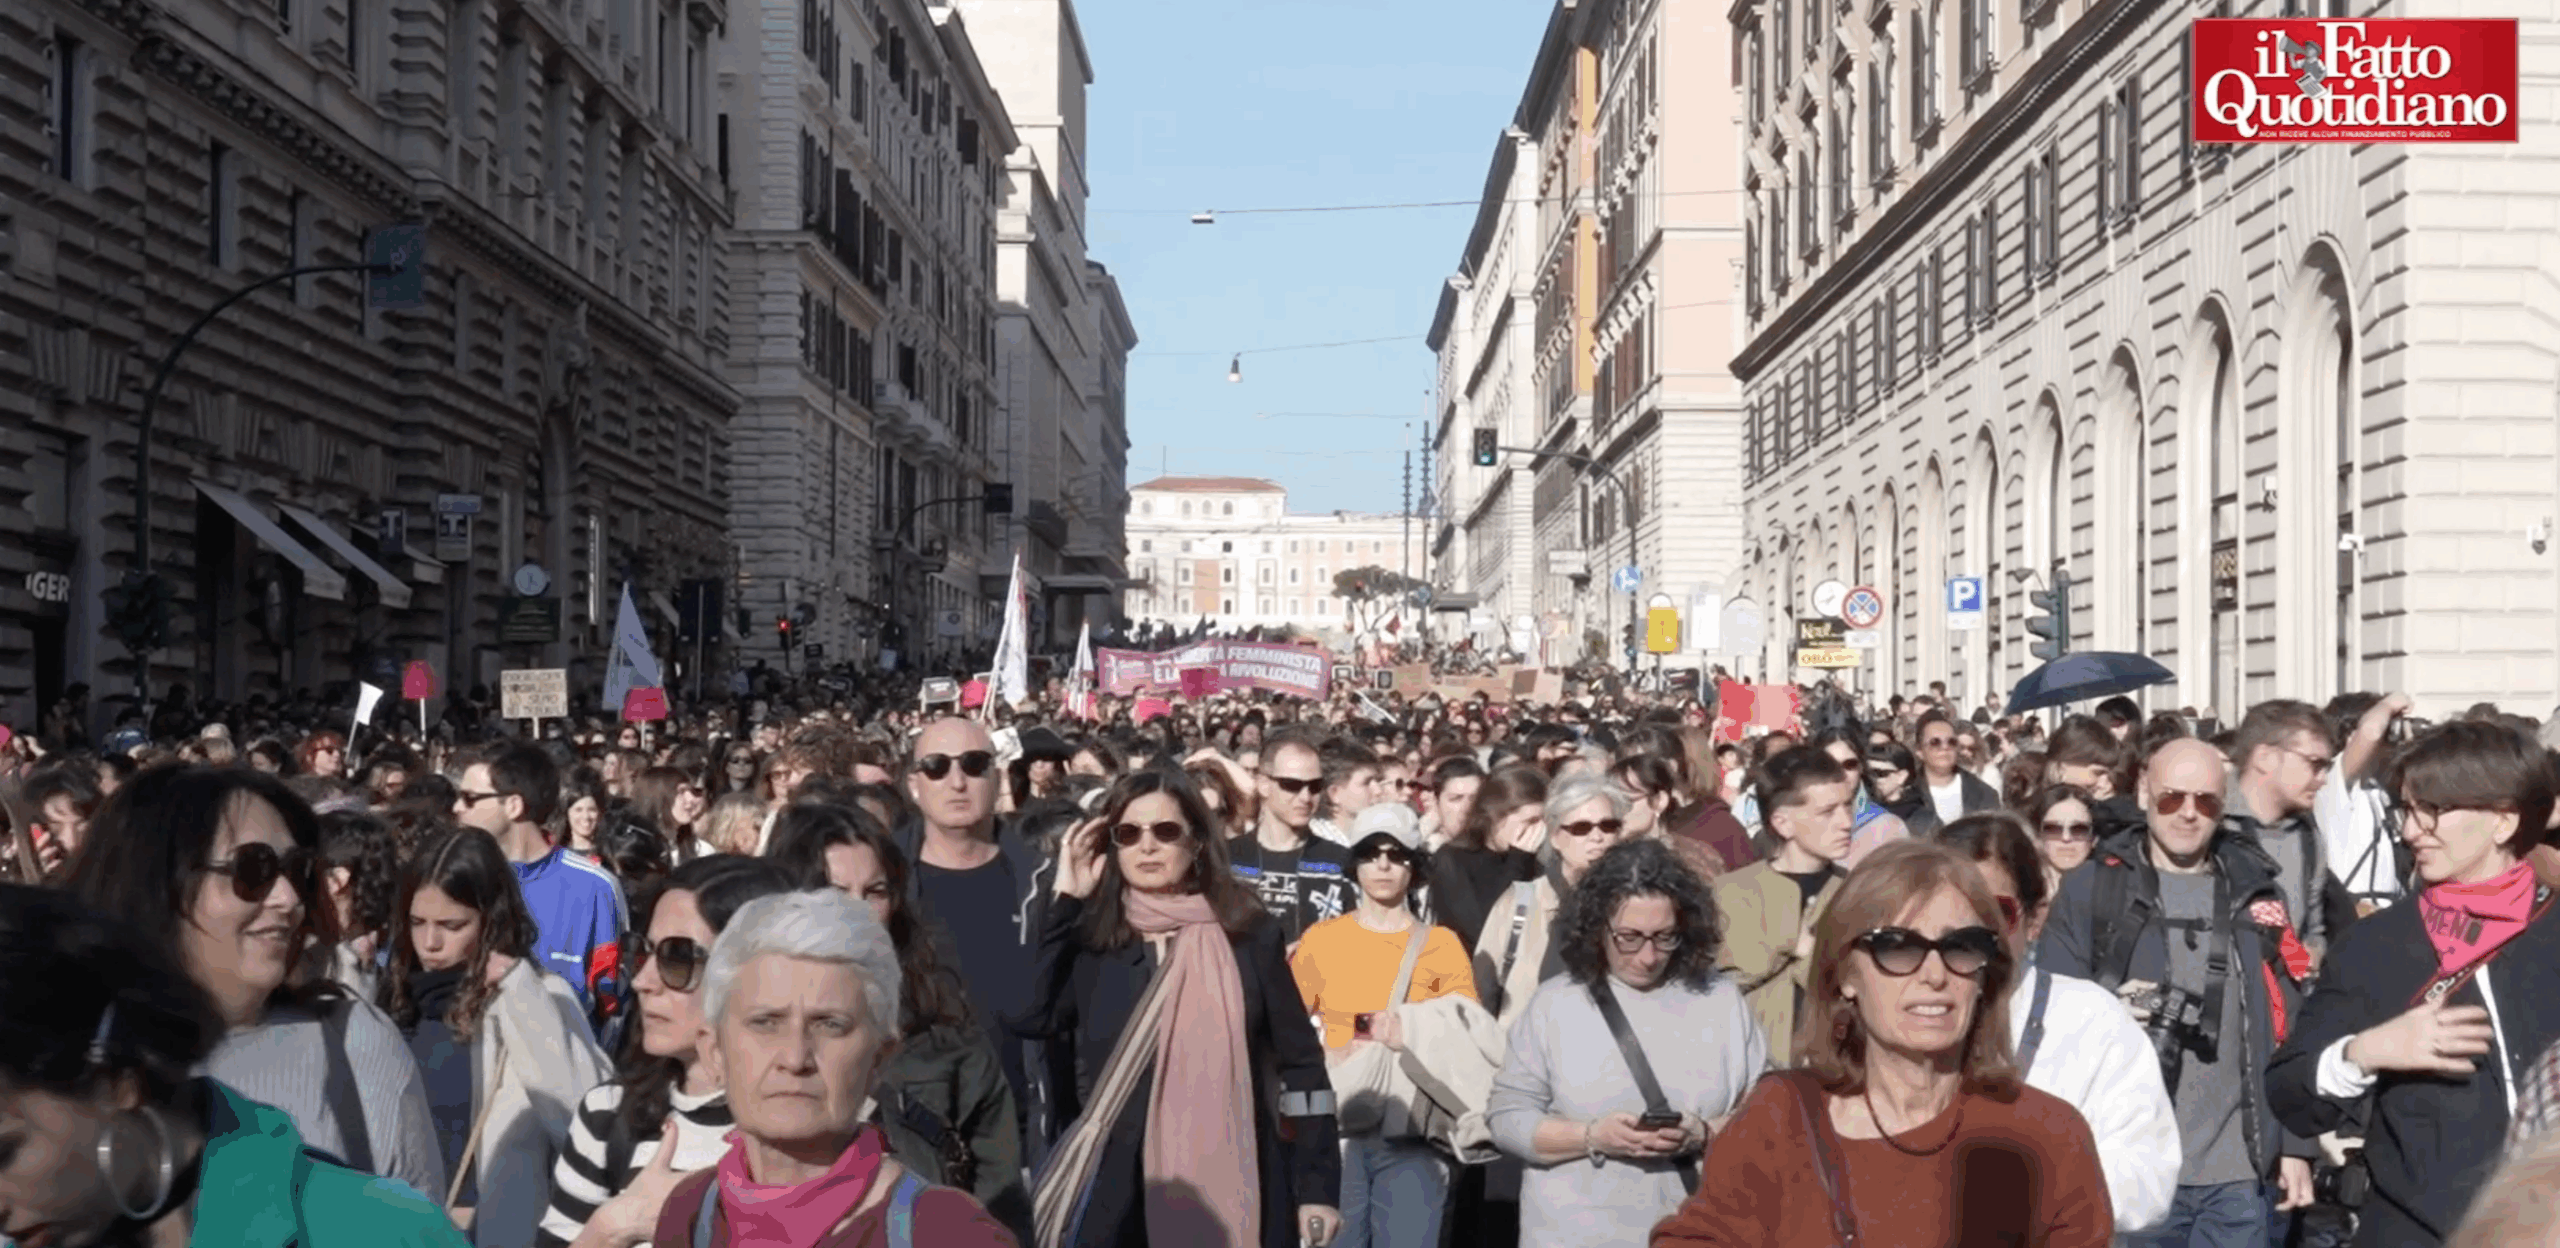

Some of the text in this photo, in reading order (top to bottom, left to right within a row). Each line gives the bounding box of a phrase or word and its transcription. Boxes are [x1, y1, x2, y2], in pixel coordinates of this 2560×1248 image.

[1953, 581, 1976, 610] P
[1227, 646, 1321, 674] FEMMINISTA
[1229, 662, 1320, 689] RIVOLUZIONE
[2423, 904, 2484, 947] MENO
